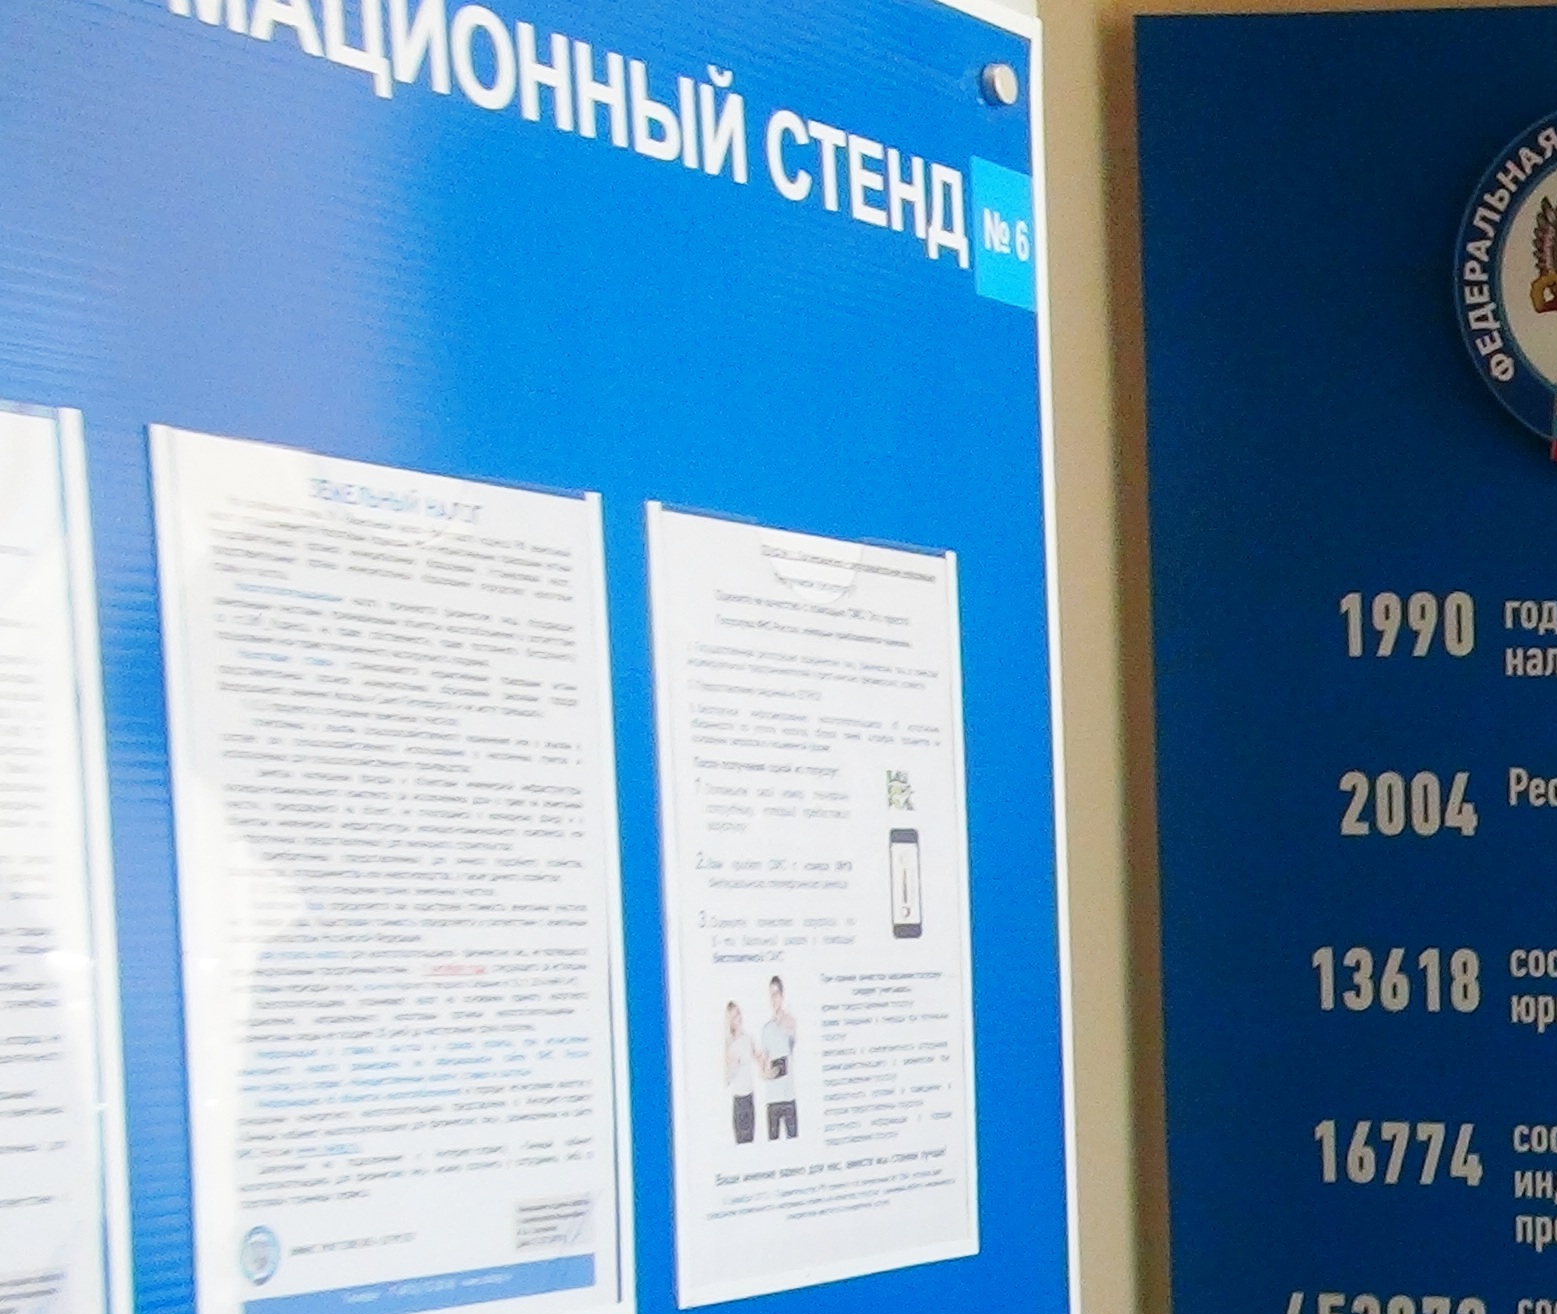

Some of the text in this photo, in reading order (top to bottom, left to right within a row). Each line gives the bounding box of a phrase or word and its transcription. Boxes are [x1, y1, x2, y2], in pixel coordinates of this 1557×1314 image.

[167, 0, 971, 269] ЦИОННЫЙ СТЕНД
[984, 209, 1030, 262] № 6
[1340, 591, 1475, 657] 1990
[1339, 770, 1478, 836] 2004
[1312, 946, 1480, 1013] 13618
[1314, 1120, 1484, 1186] 16774
